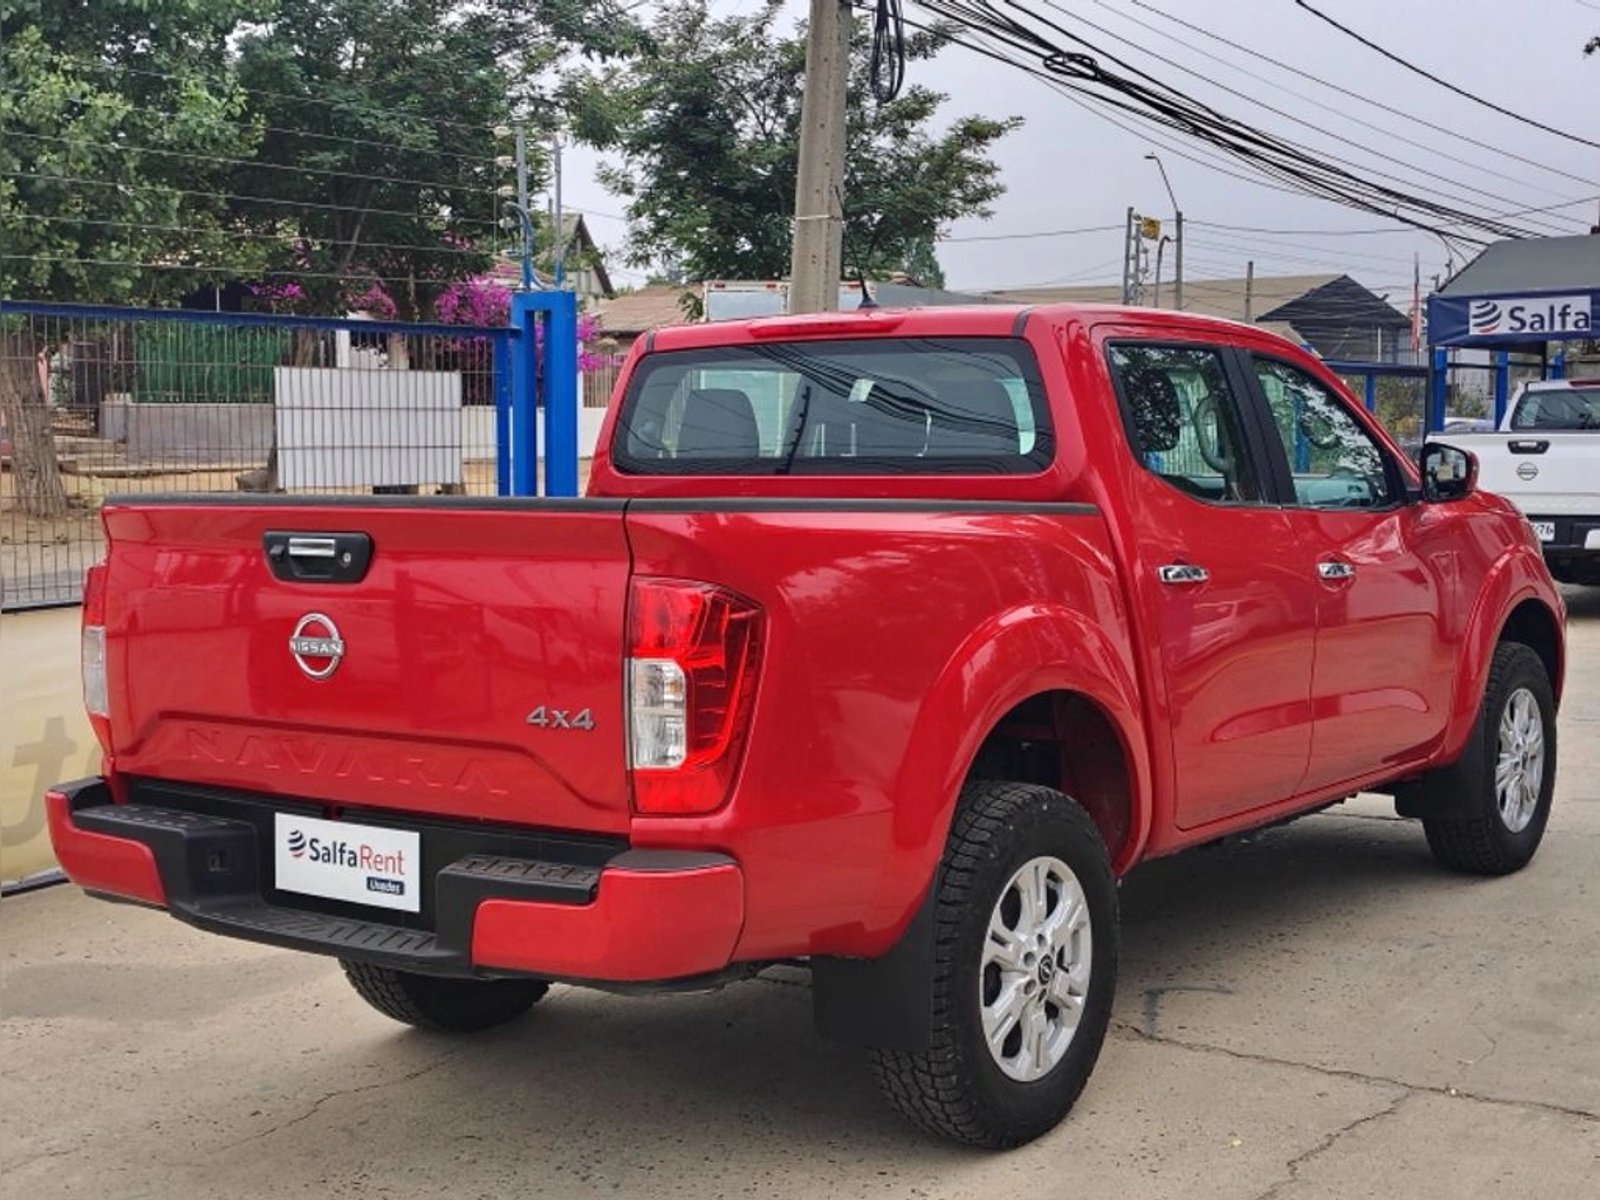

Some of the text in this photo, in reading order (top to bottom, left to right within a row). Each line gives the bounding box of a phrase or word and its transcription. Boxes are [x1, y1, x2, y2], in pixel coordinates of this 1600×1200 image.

[1508, 303, 1590, 332] Salfa
[291, 639, 343, 655] NISSAN
[525, 706, 597, 730] 4x4
[186, 728, 510, 796] NAVARA
[308, 838, 405, 876] SalfaRent
